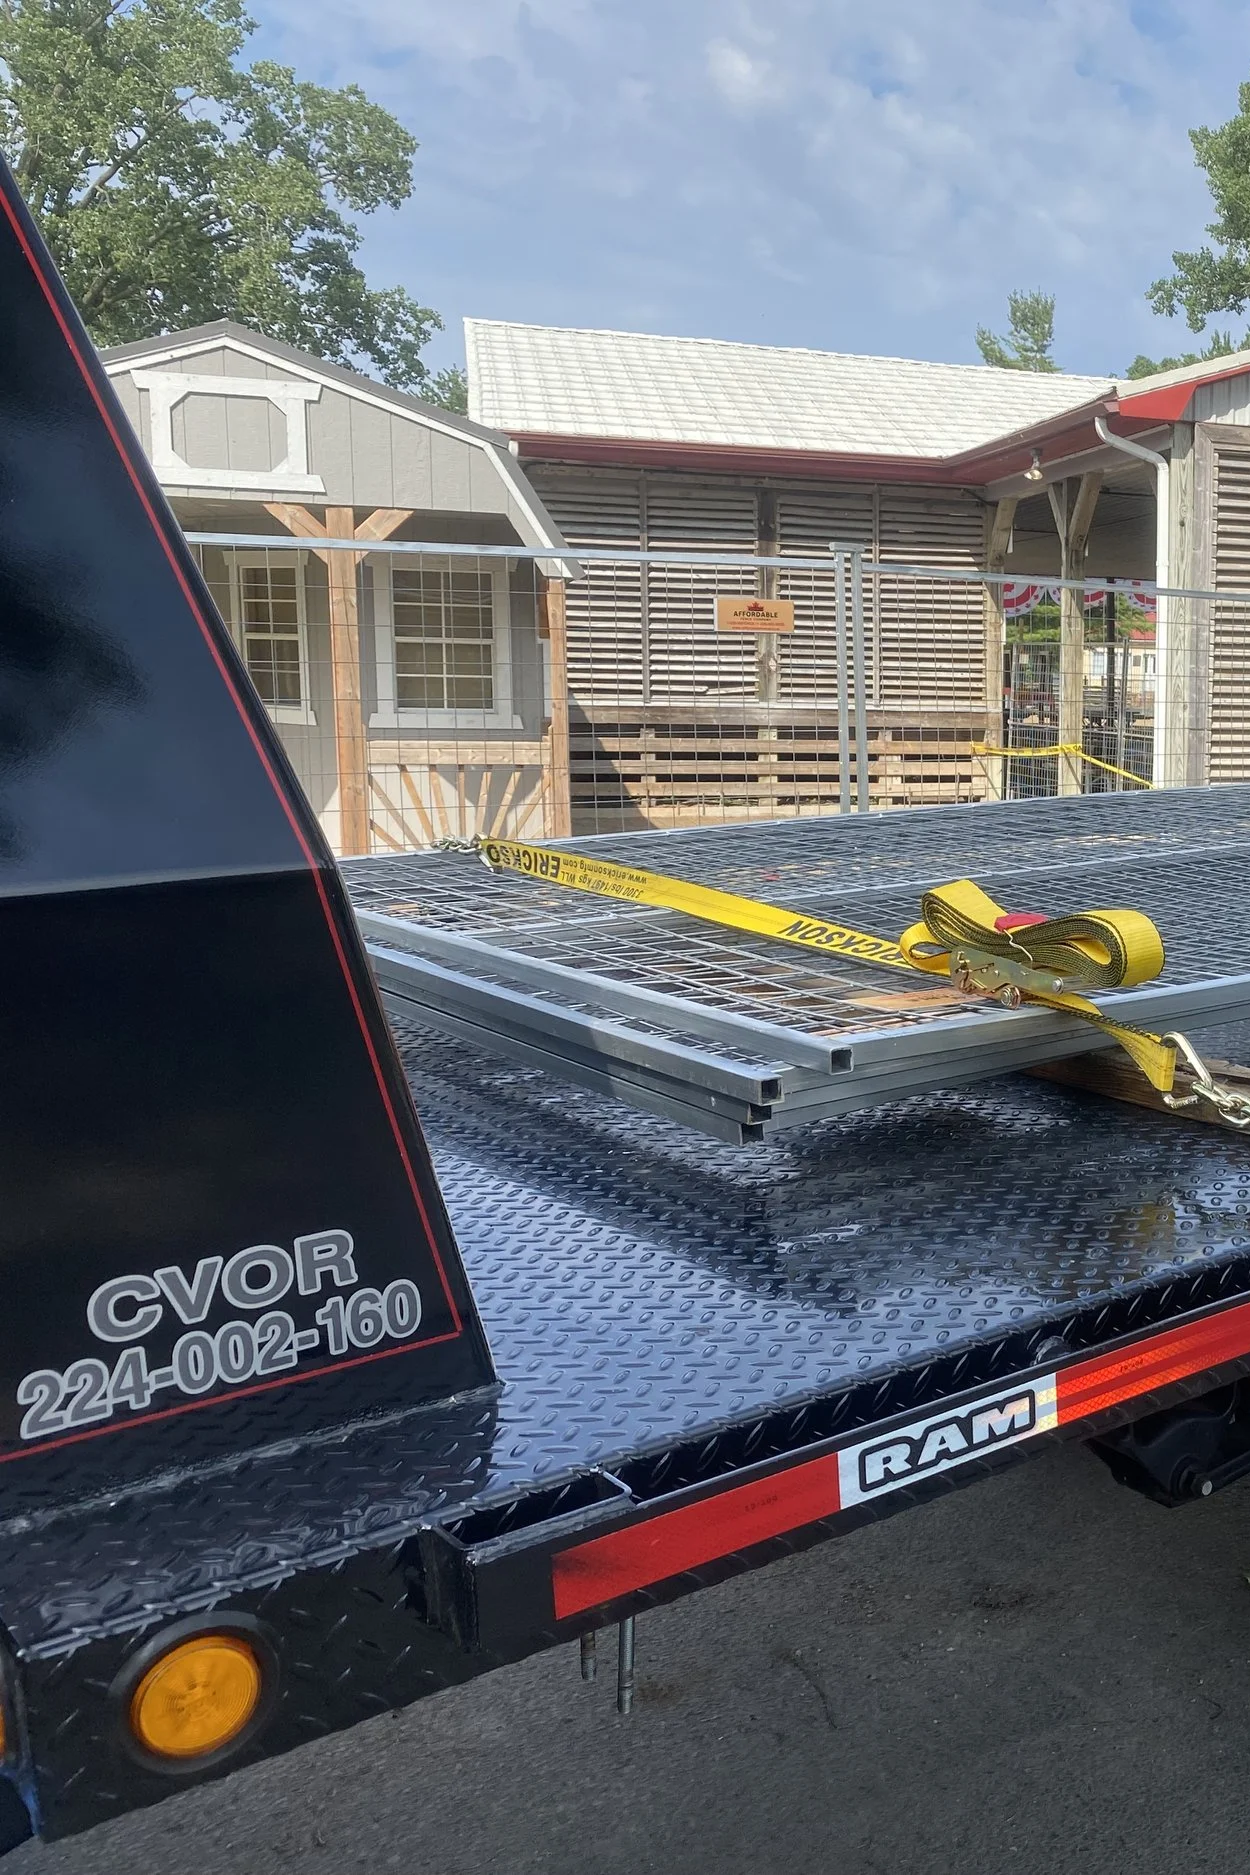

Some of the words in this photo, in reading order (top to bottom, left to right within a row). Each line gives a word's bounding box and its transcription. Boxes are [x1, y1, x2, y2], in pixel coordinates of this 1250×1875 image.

[733, 610, 778, 618] AFFORDABLE
[561, 870, 576, 884] WLL
[563, 859, 647, 885] www.ericksonmfg.com
[578, 873, 592, 887] kgs
[776, 920, 904, 962] RICKSON
[87, 1229, 358, 1343] CVOR
[17, 1278, 422, 1439] 224-002-160
[859, 1388, 1036, 1493] RAM
